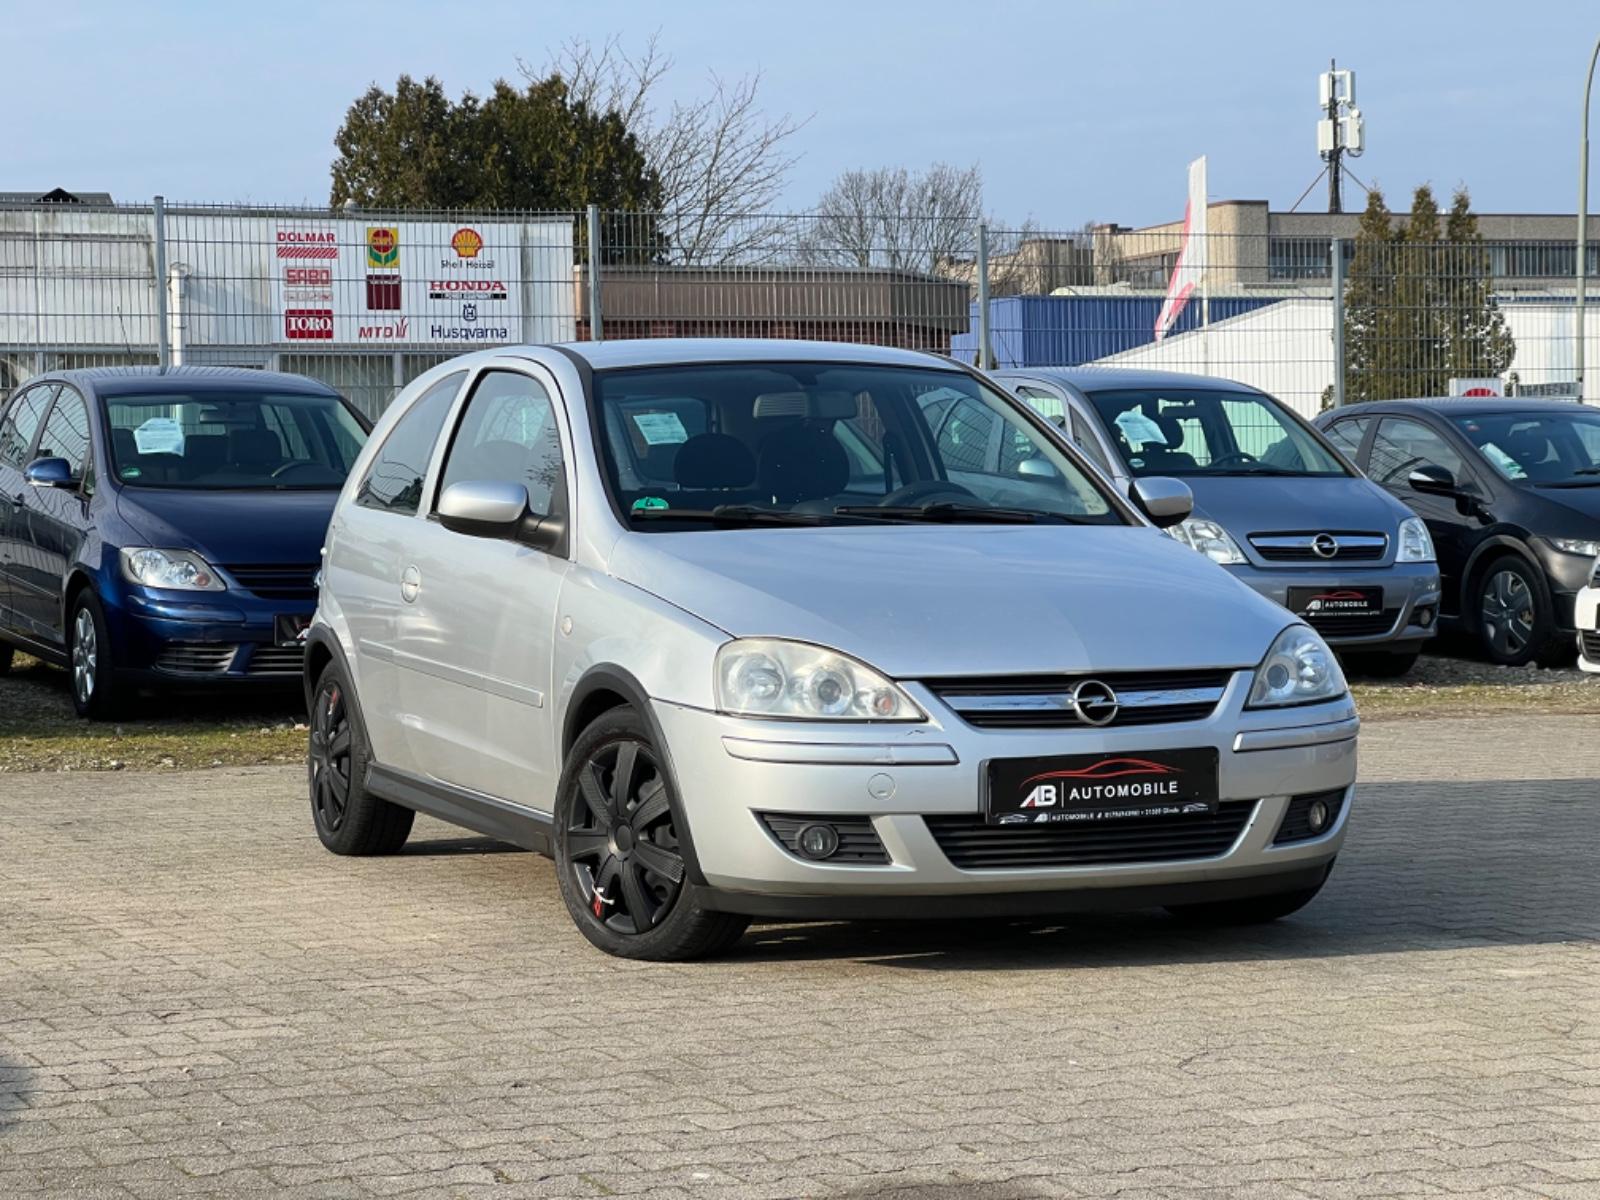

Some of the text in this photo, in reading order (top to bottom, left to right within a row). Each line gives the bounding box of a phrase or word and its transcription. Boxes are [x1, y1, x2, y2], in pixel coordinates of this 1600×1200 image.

[277, 232, 336, 242] DOLMAR
[430, 281, 507, 291] HONDA
[288, 317, 331, 331] TORO
[359, 326, 393, 338] MTD
[431, 325, 507, 340] Husqvarna
[1019, 780, 1179, 809] AB AUTOMOBILE
